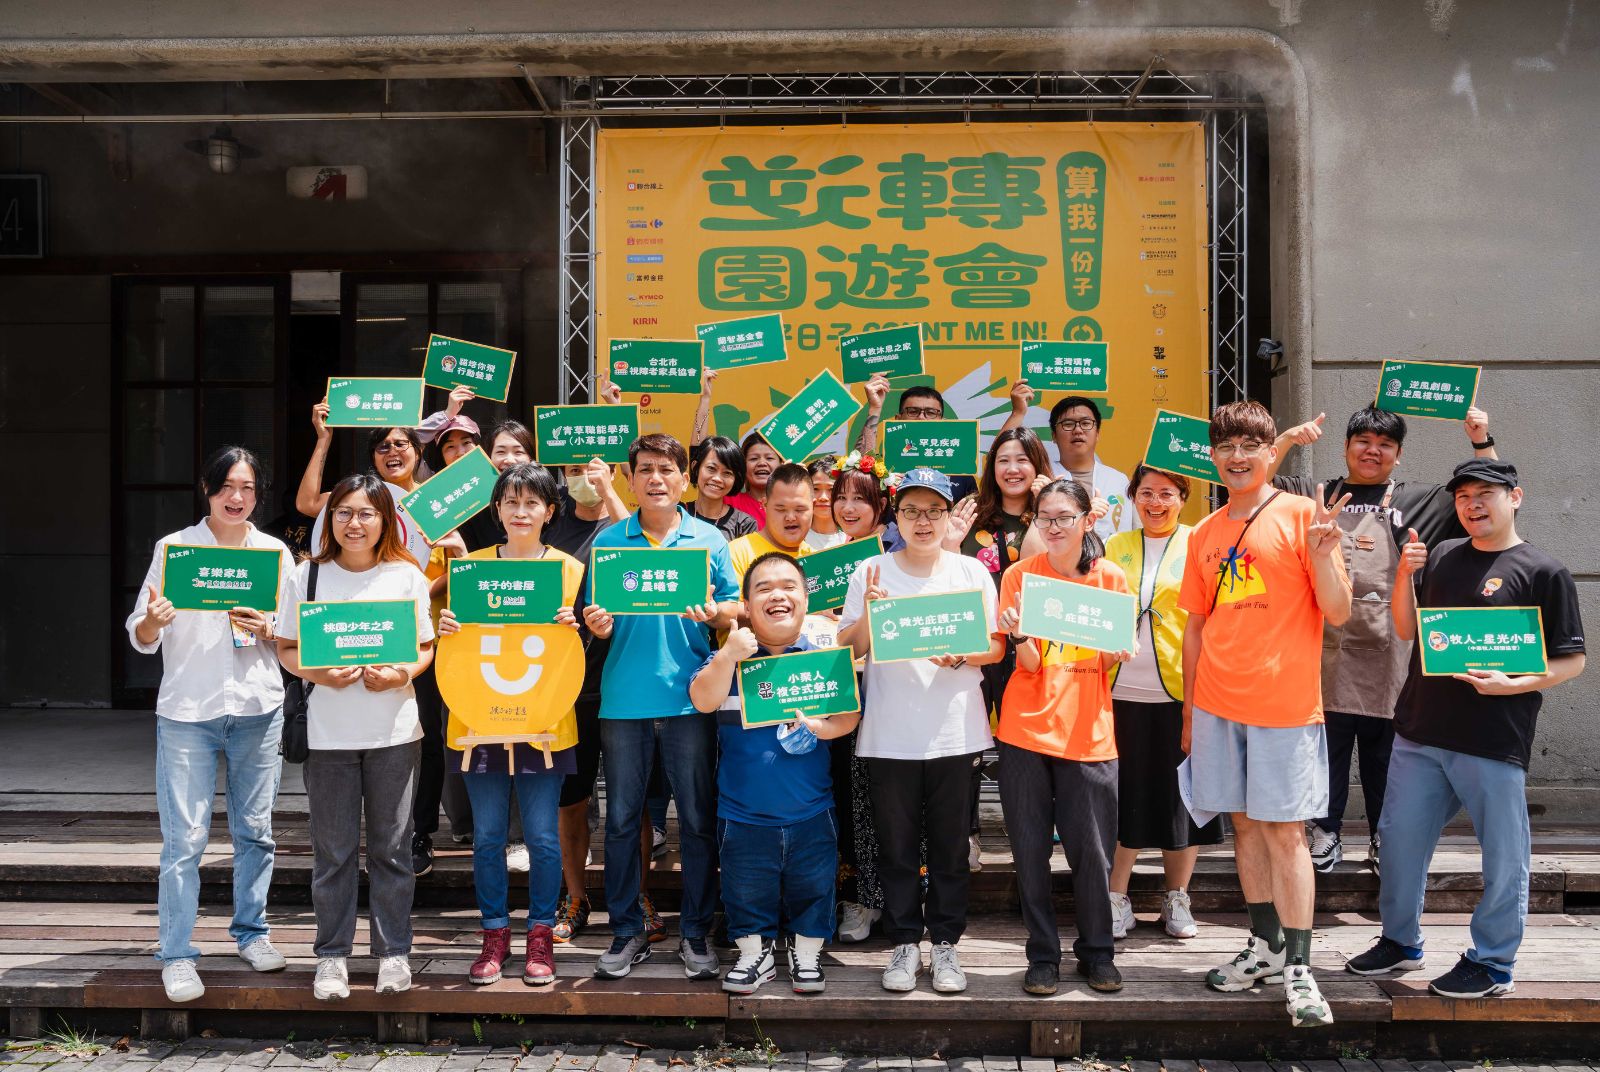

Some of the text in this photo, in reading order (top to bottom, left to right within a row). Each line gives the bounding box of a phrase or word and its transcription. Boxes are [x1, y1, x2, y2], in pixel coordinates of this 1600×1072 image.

[1064, 166, 1099, 297] 算我一份子
[697, 242, 1048, 312] 園遊會
[965, 321, 1005, 341] ME
[1011, 321, 1048, 341] IN!
[850, 342, 912, 358] 基督教沐恩之家
[649, 357, 678, 367] 台北市
[629, 366, 697, 376] 視障者家長協會
[1044, 366, 1102, 375] 文教發展協會
[1409, 380, 1451, 392] 逆風劇團
[805, 399, 838, 431] 庇護工場
[562, 424, 630, 435] 青草職能學苑
[919, 438, 960, 447] 罕見疾病
[924, 448, 955, 457] 基金會
[198, 567, 248, 579] 喜樂家族
[641, 569, 679, 580] 基督教
[477, 580, 536, 591] 孩子的書屋
[641, 581, 679, 592] 晨曦會
[899, 611, 975, 628] 微光庇護工場
[1064, 613, 1114, 631] 庇護工場
[323, 621, 394, 633] 桃園少年之家
[919, 624, 957, 638] 蘆竹店
[1449, 633, 1537, 645] 牧人-星光小屋
[788, 670, 825, 684] 小聚人
[776, 680, 839, 697] 複合式餐飲
